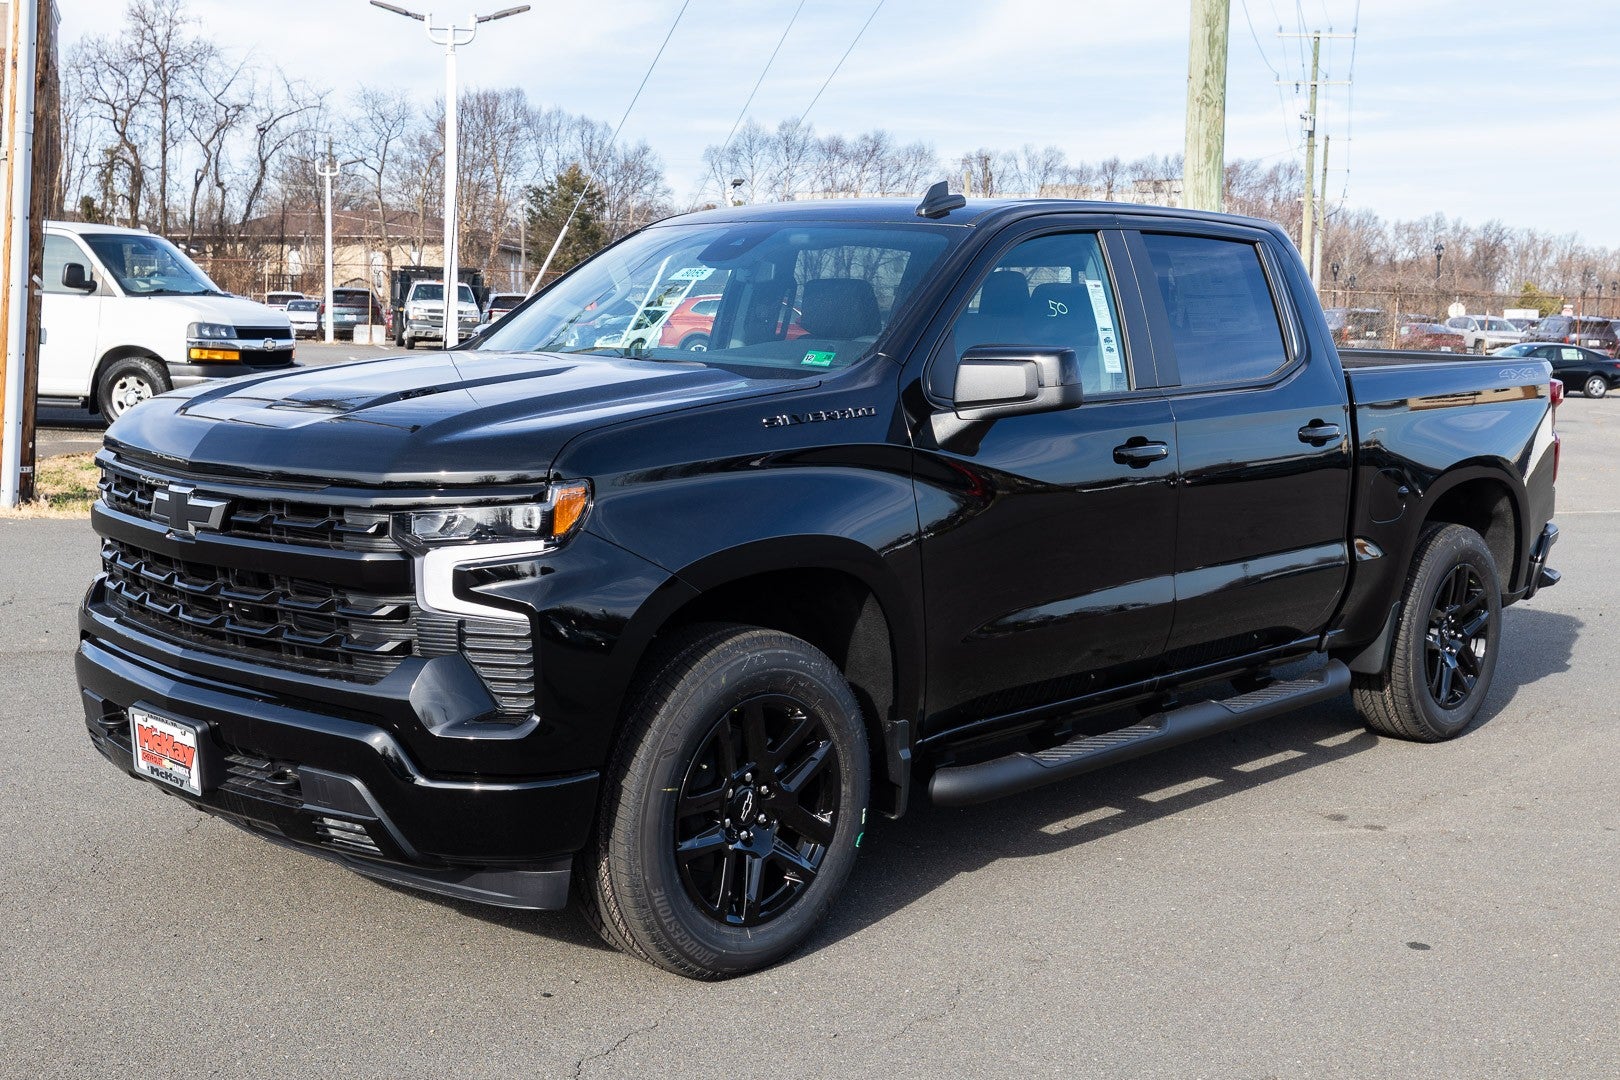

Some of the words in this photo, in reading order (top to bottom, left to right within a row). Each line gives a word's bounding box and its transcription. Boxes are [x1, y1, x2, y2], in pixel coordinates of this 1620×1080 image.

[1047, 300, 1068, 316] 50
[762, 406, 877, 429] SILVERADO
[137, 724, 196, 769] McKay
[150, 766, 184, 787] McKay
[651, 886, 719, 966] BRIDGESTONE
